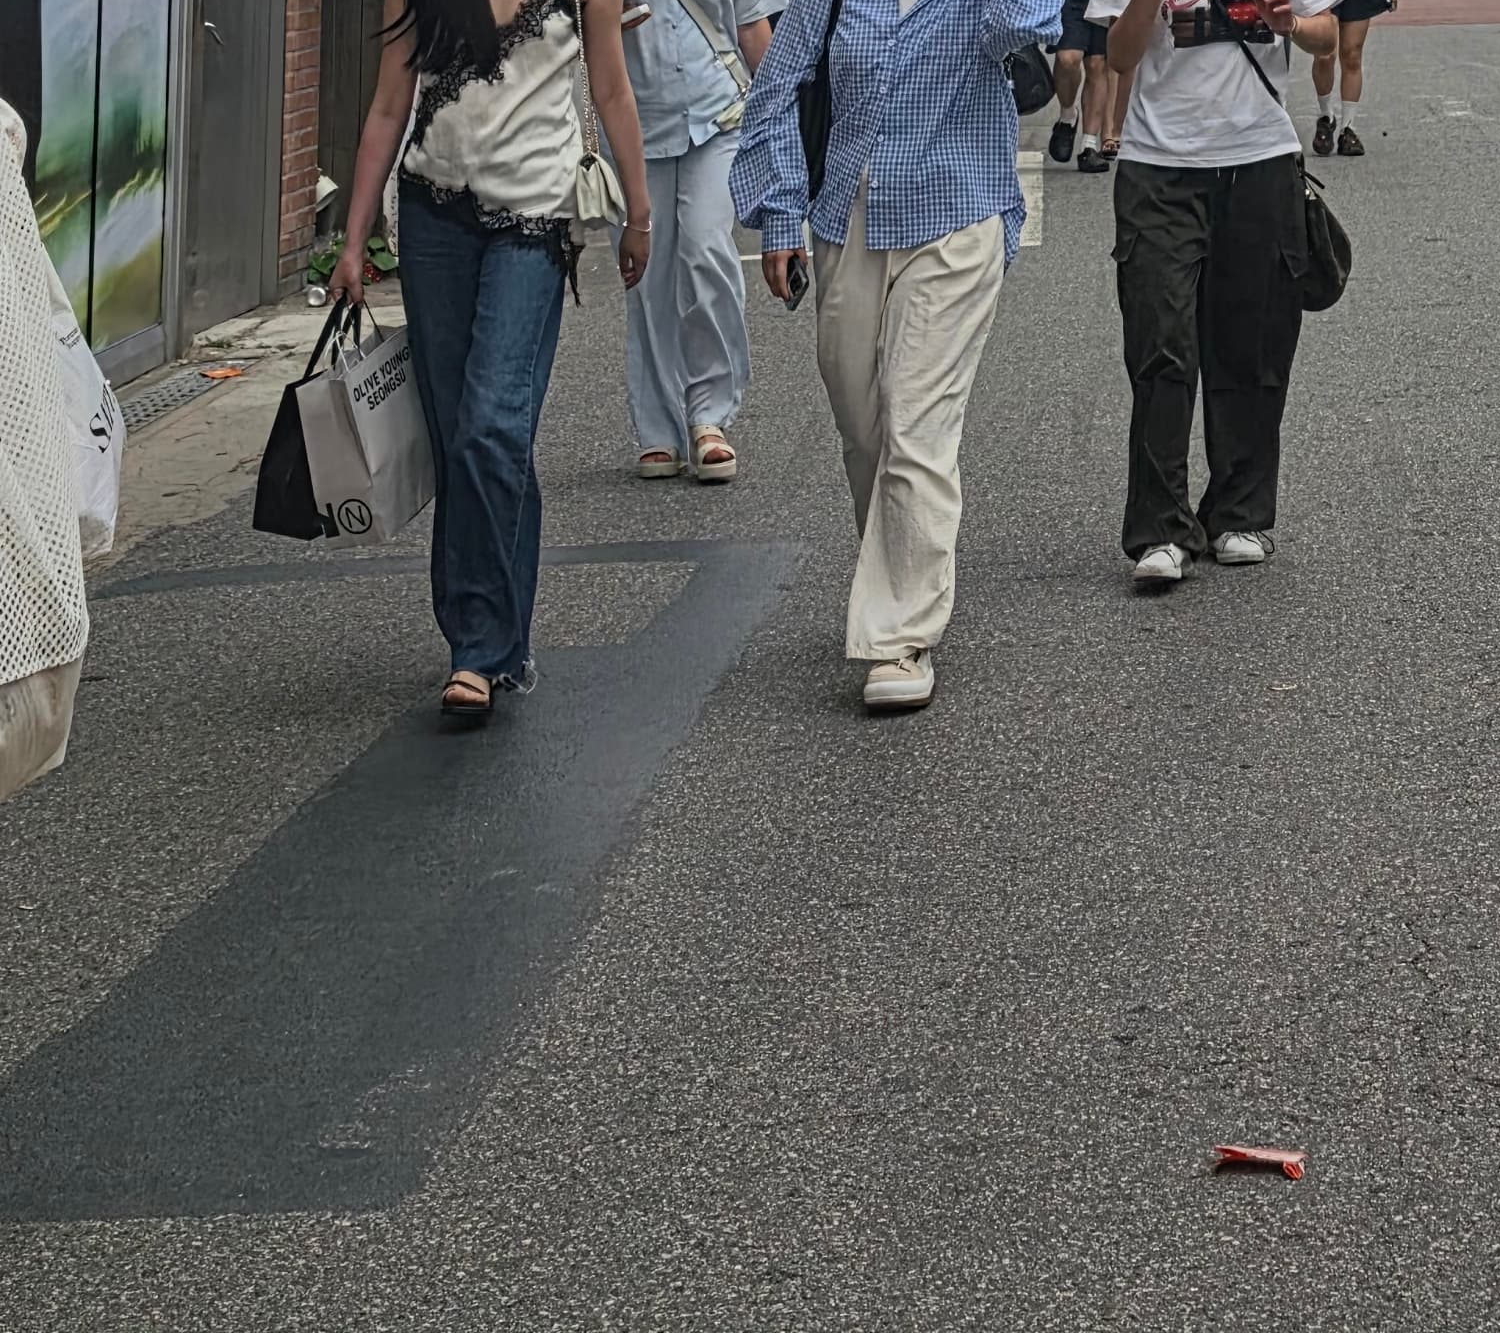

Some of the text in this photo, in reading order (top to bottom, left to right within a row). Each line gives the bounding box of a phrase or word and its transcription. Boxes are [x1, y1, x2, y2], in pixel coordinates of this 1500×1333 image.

[353, 346, 410, 402] OLIVE YOUNG
[367, 369, 406, 410] SEONGSU
